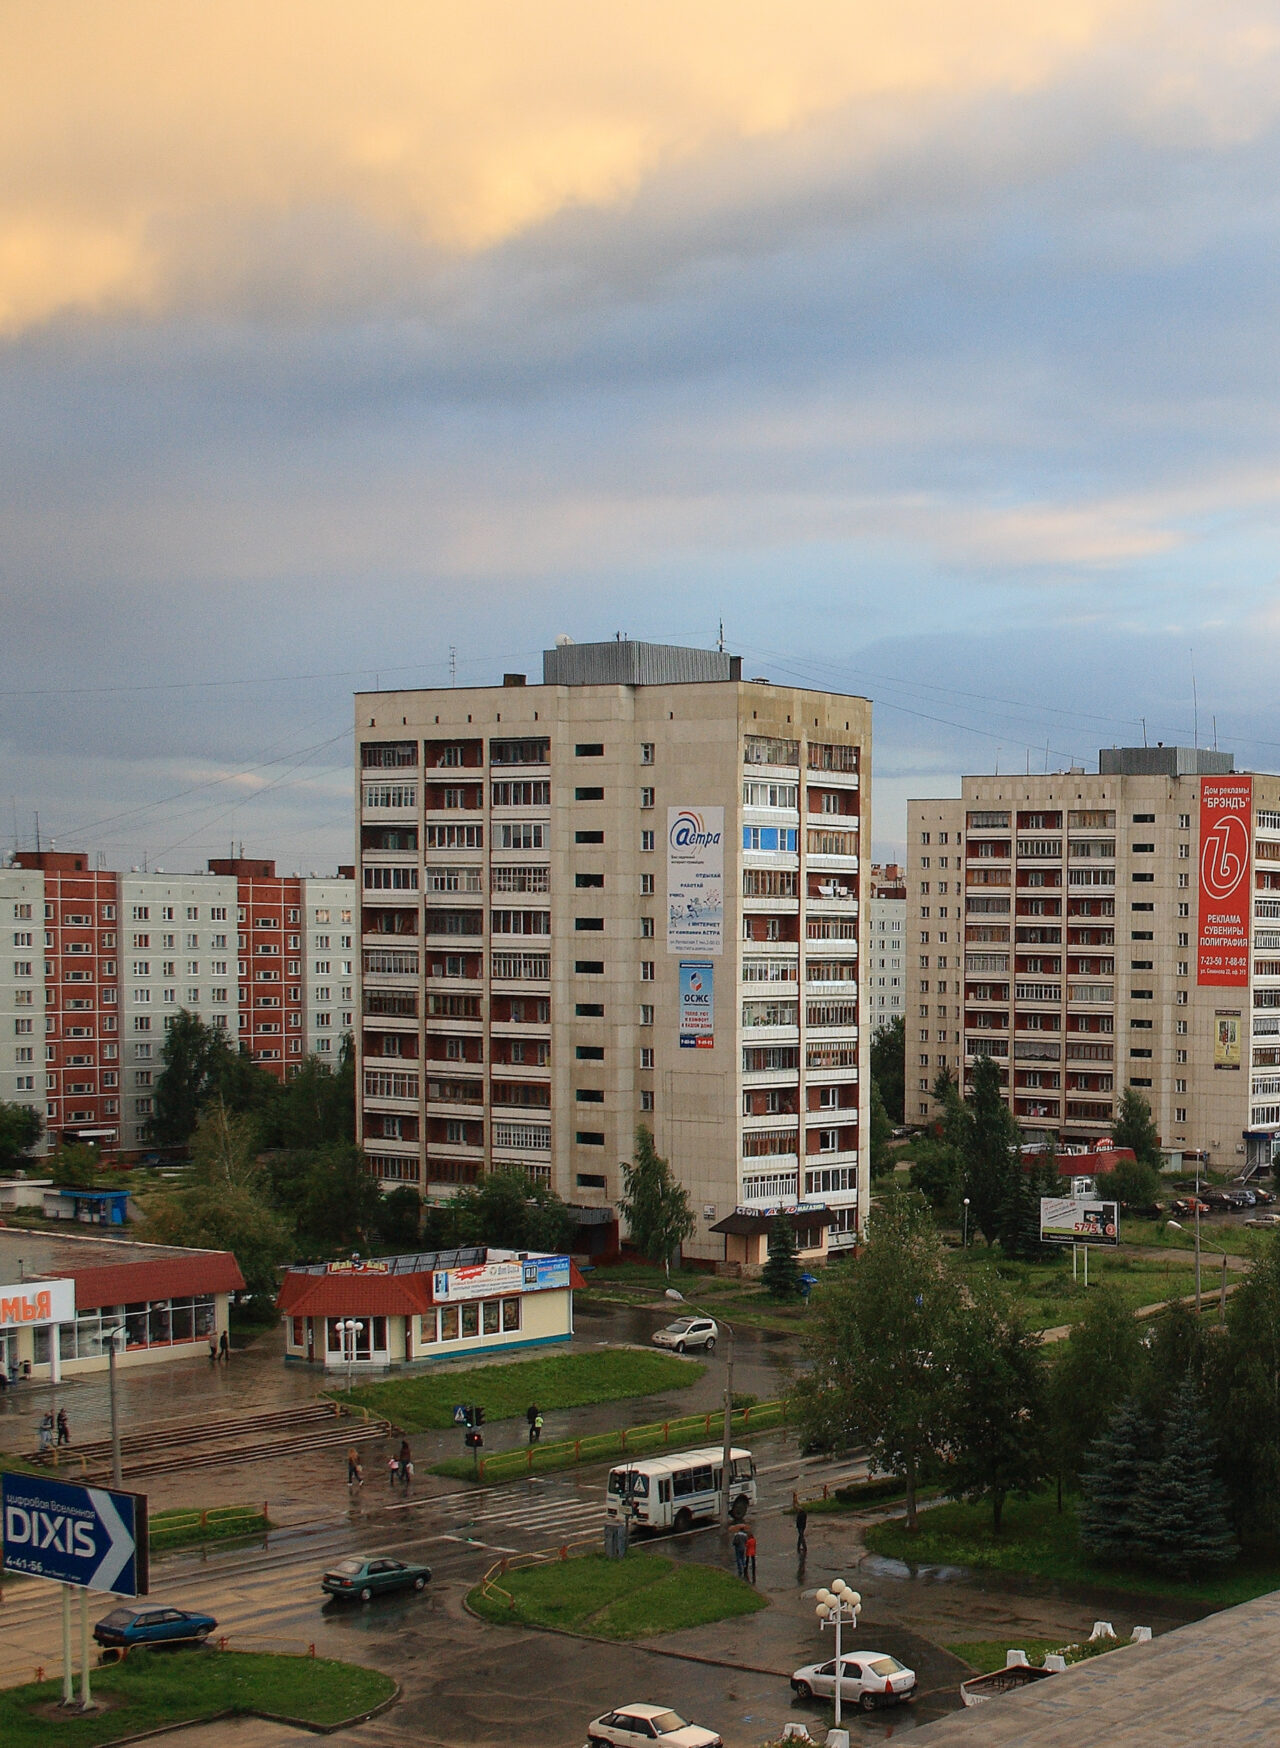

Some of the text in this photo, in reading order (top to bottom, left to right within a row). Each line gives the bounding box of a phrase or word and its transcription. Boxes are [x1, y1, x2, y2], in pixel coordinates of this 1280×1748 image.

[1204, 785, 1250, 796] Дом рекламы
[1207, 914, 1241, 924] РЕКЛАМА
[1204, 926, 1244, 935] СУВЕНИРЫ
[1200, 937, 1248, 947] ПОЛИГРАФИЯ
[6, 1494, 50, 1510] цифровая
[6, 1505, 97, 1558] DIXIS
[6, 1555, 43, 1572] 4-41-56
